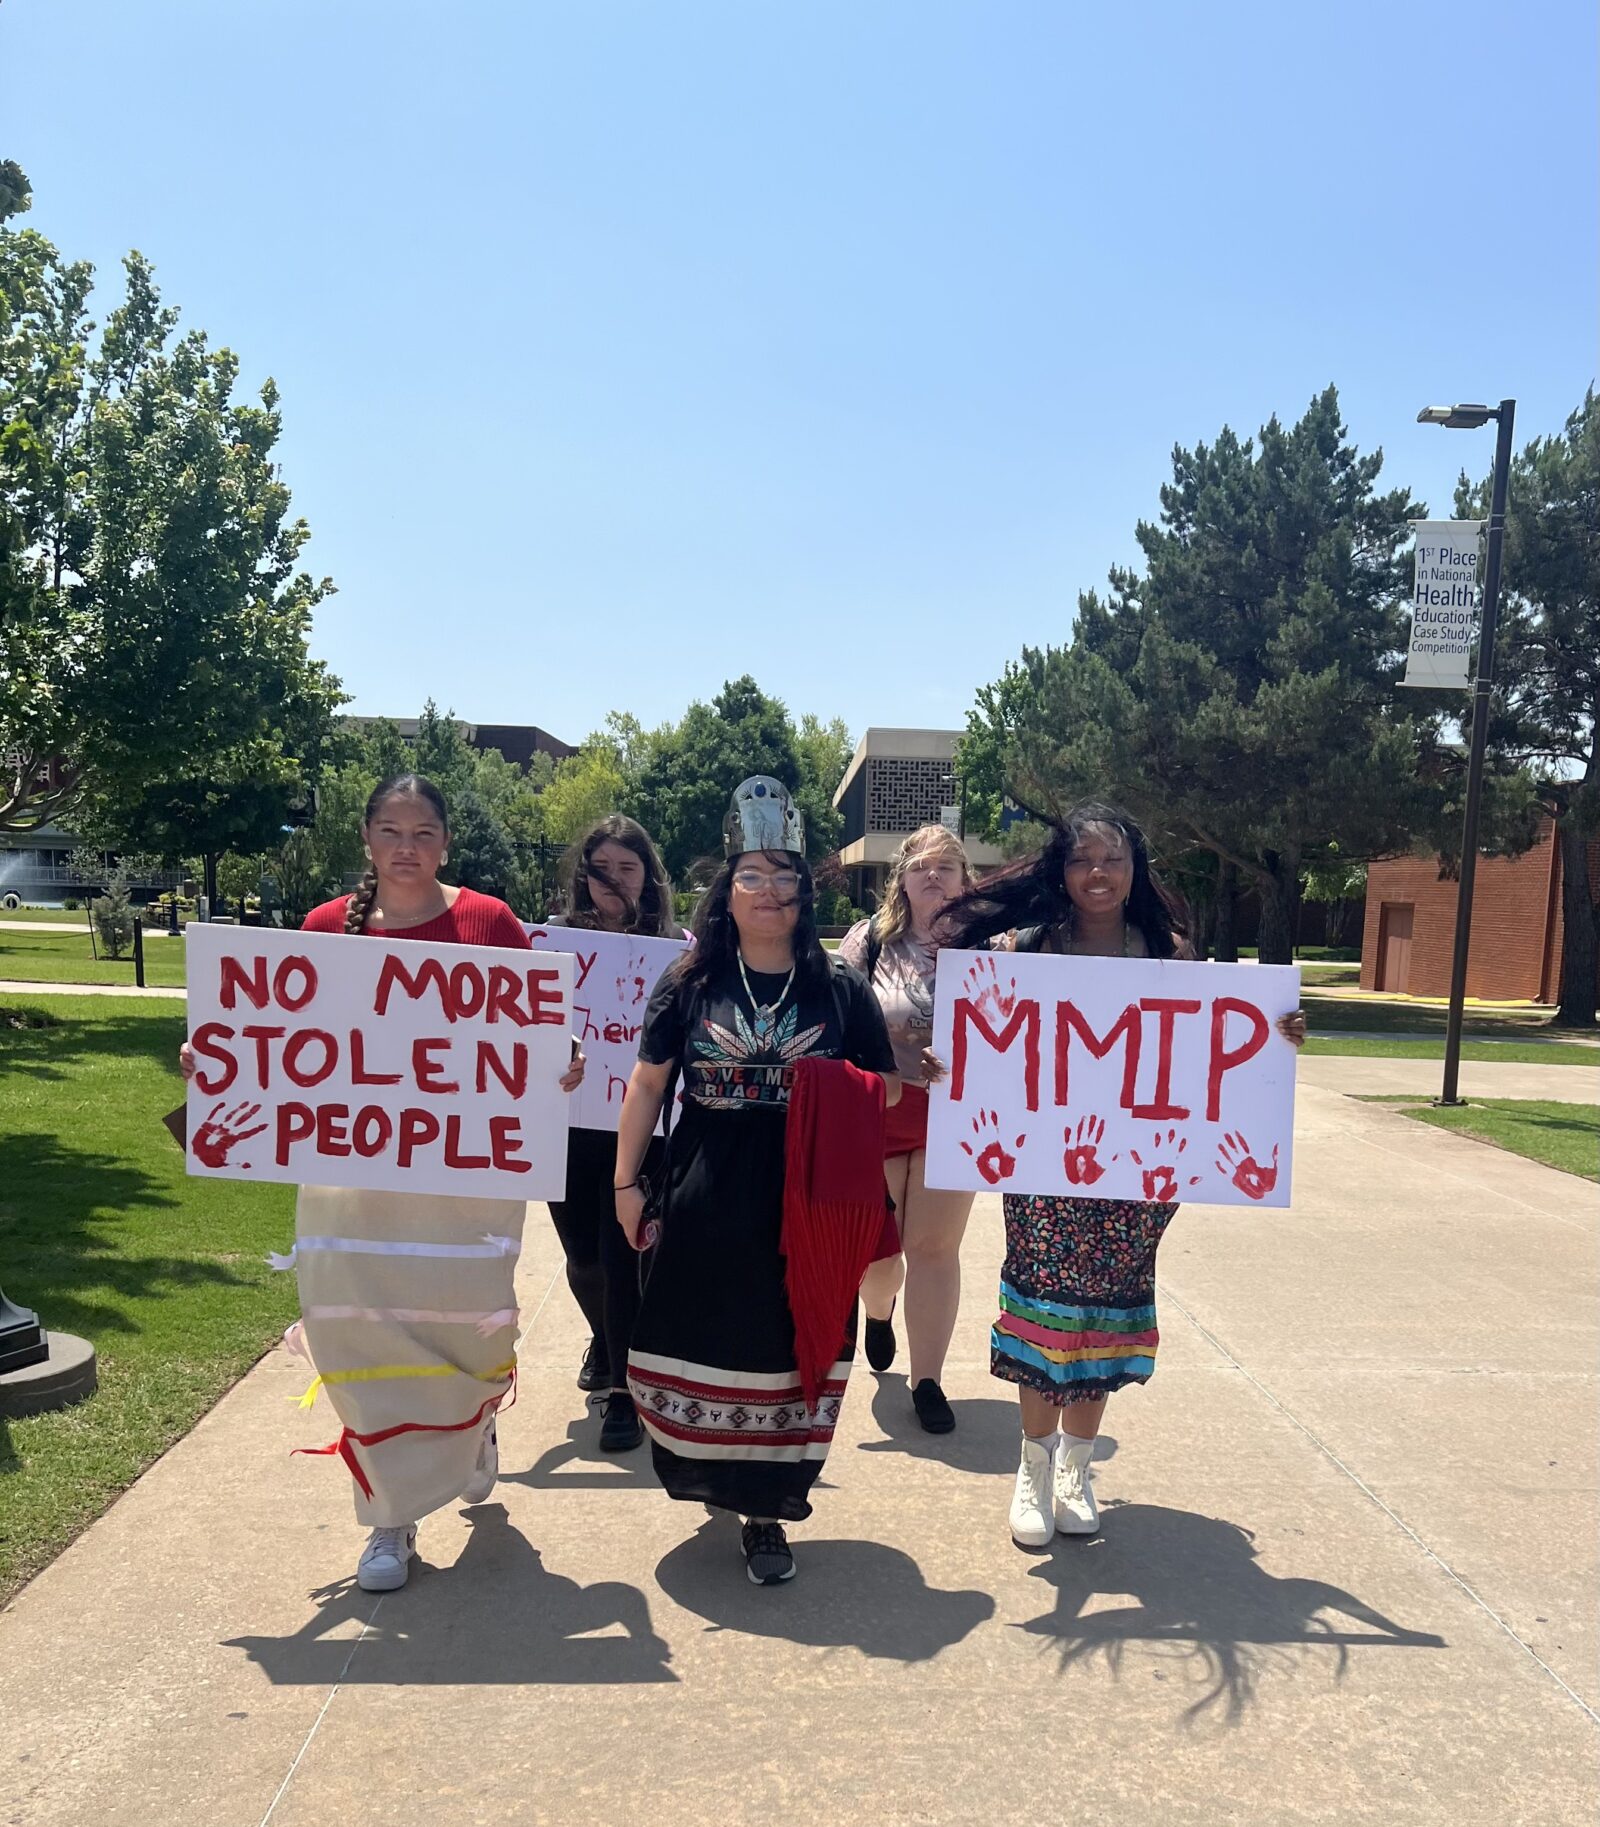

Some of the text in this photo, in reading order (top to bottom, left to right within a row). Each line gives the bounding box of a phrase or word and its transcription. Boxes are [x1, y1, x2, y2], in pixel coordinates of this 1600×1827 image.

[1419, 547, 1477, 566] 1ST Place
[1417, 566, 1476, 582] in National
[1416, 583, 1474, 607] Health
[1414, 607, 1473, 624] Education
[1413, 624, 1471, 644] Case Study
[1411, 640, 1469, 656] Competition
[219, 955, 318, 1013] NO
[374, 953, 565, 1027] MORE
[191, 1022, 529, 1099] STOLEN
[949, 997, 1269, 1122] MMIP
[275, 1101, 532, 1173] PEOPLE
